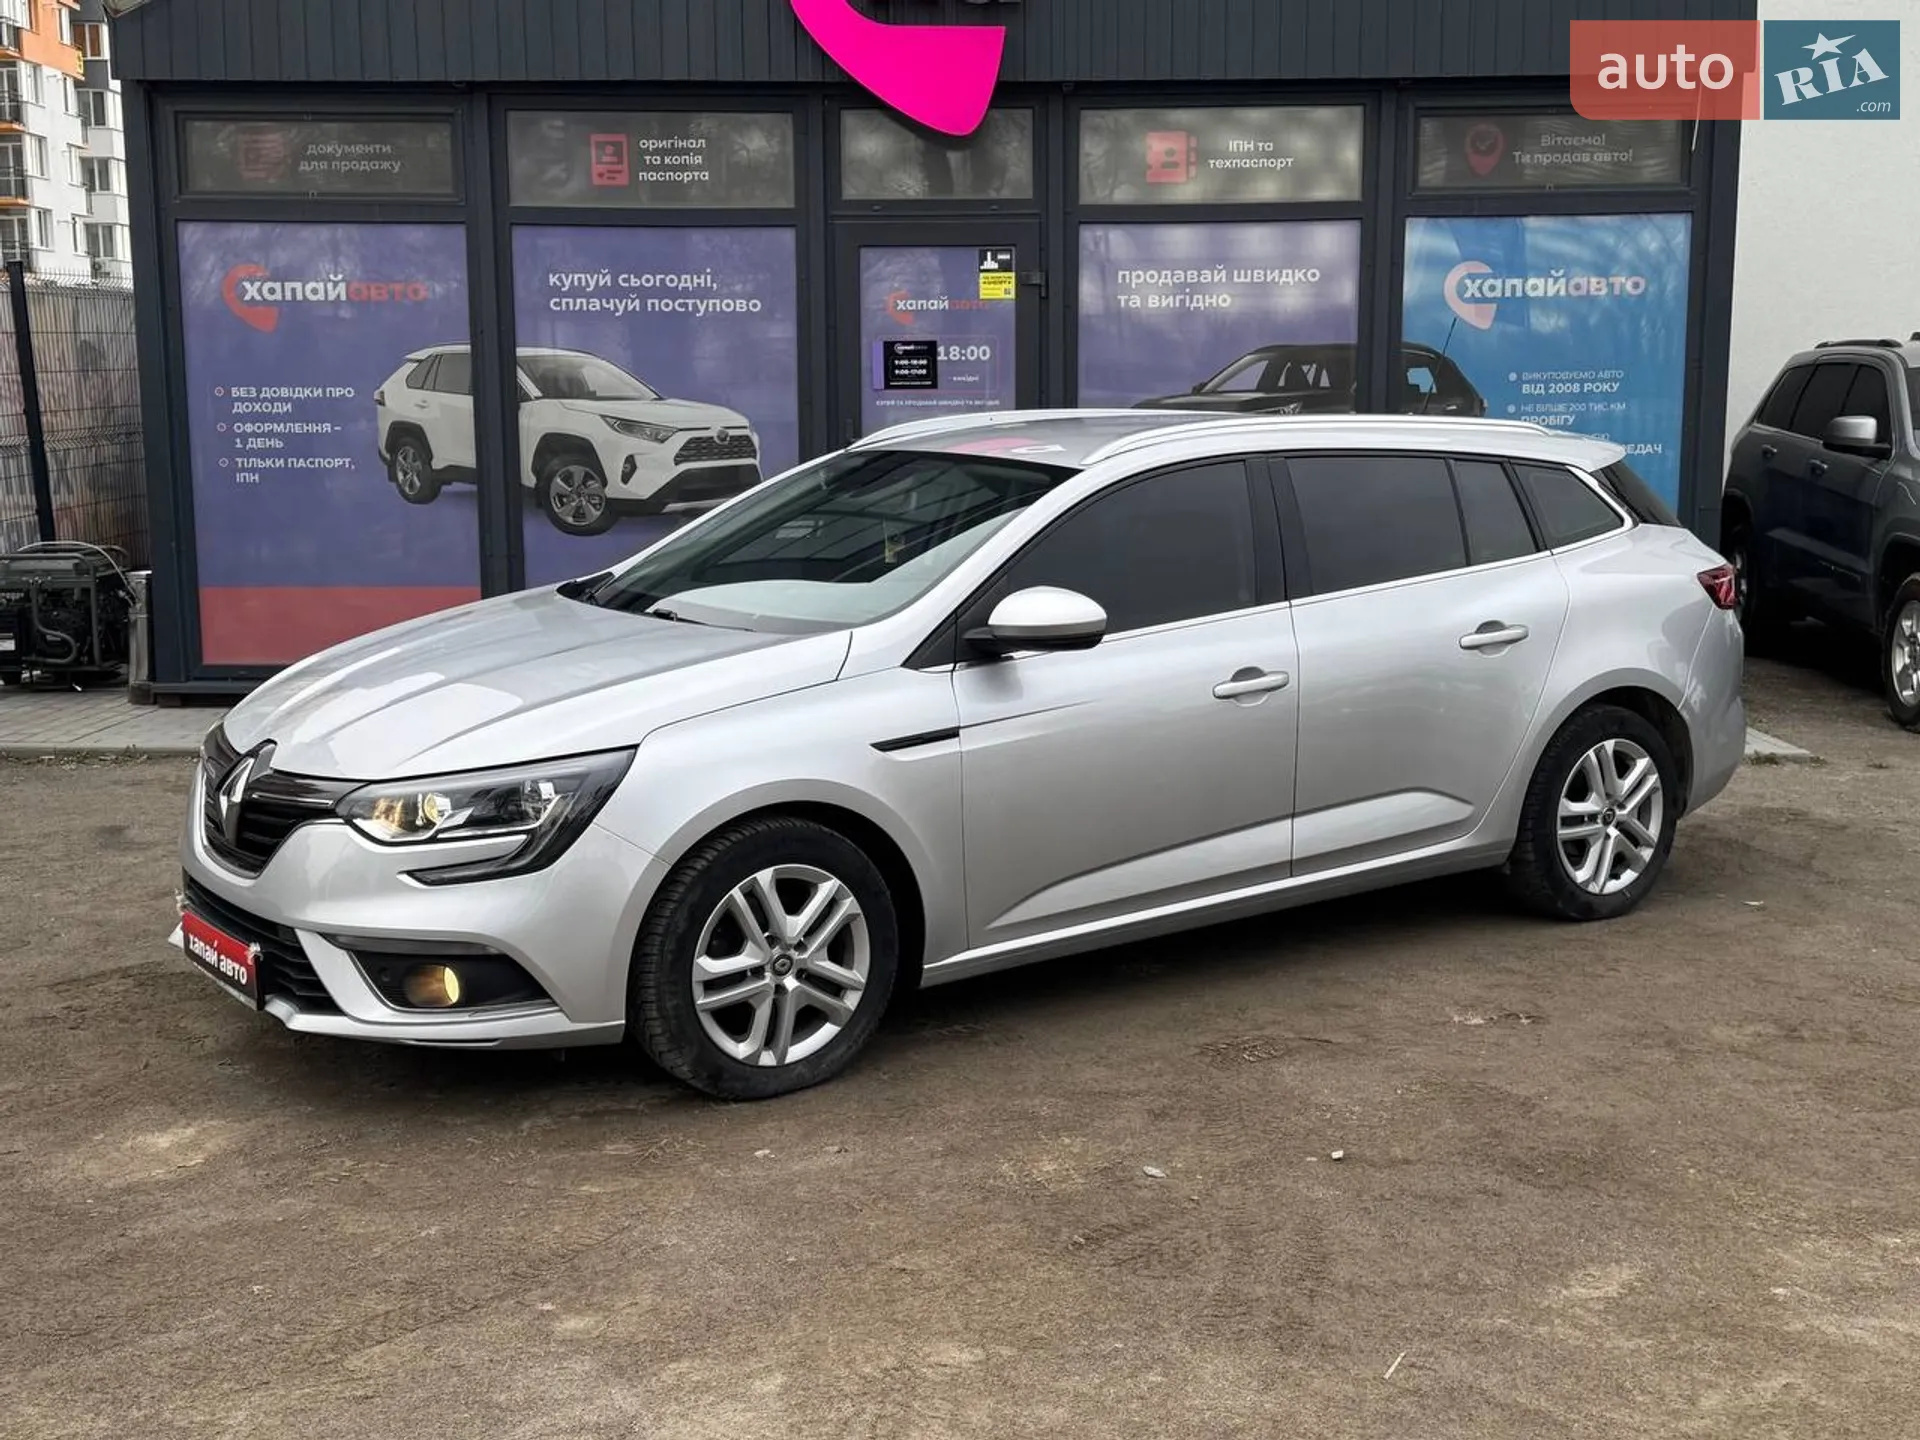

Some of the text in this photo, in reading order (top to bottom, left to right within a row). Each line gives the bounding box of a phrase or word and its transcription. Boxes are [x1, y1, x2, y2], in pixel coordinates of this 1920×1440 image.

[639, 136, 706, 151] оригінал
[1228, 139, 1274, 153] ІПН та
[1540, 133, 1606, 147] Вітаємо!
[306, 142, 392, 158] документи
[1512, 148, 1634, 166] Ти продав авто!
[299, 158, 401, 173] для продажу
[643, 152, 702, 165] та копія
[1207, 157, 1295, 171] техпаспорт
[638, 170, 709, 184] паспорта
[549, 268, 718, 292] купуй сьогодні,
[1117, 264, 1321, 289] продавай швидко
[549, 294, 763, 317] сплачуй поступово
[1117, 288, 1232, 311] та вигідно
[937, 345, 991, 361] 18:00
[1597, 369, 1625, 379] АВТО
[231, 386, 355, 400] БЕЗ ДОВІДКИ ПРО
[1521, 381, 1620, 395] ВІД 2008 РОКУ
[232, 401, 293, 414] ДОХОДИ
[1520, 403, 1535, 413] НЕ
[1569, 402, 1587, 412] 200
[1520, 414, 1576, 426] ПРОБІГУ
[233, 422, 332, 434] ОФОРМЛЕННЯ
[234, 438, 284, 450] 1 ДЕНЬ
[235, 457, 356, 470] ТІЛЬКИ ПАСПОРТ,
[235, 472, 260, 484] ІПН
[219, 954, 248, 985] авто
